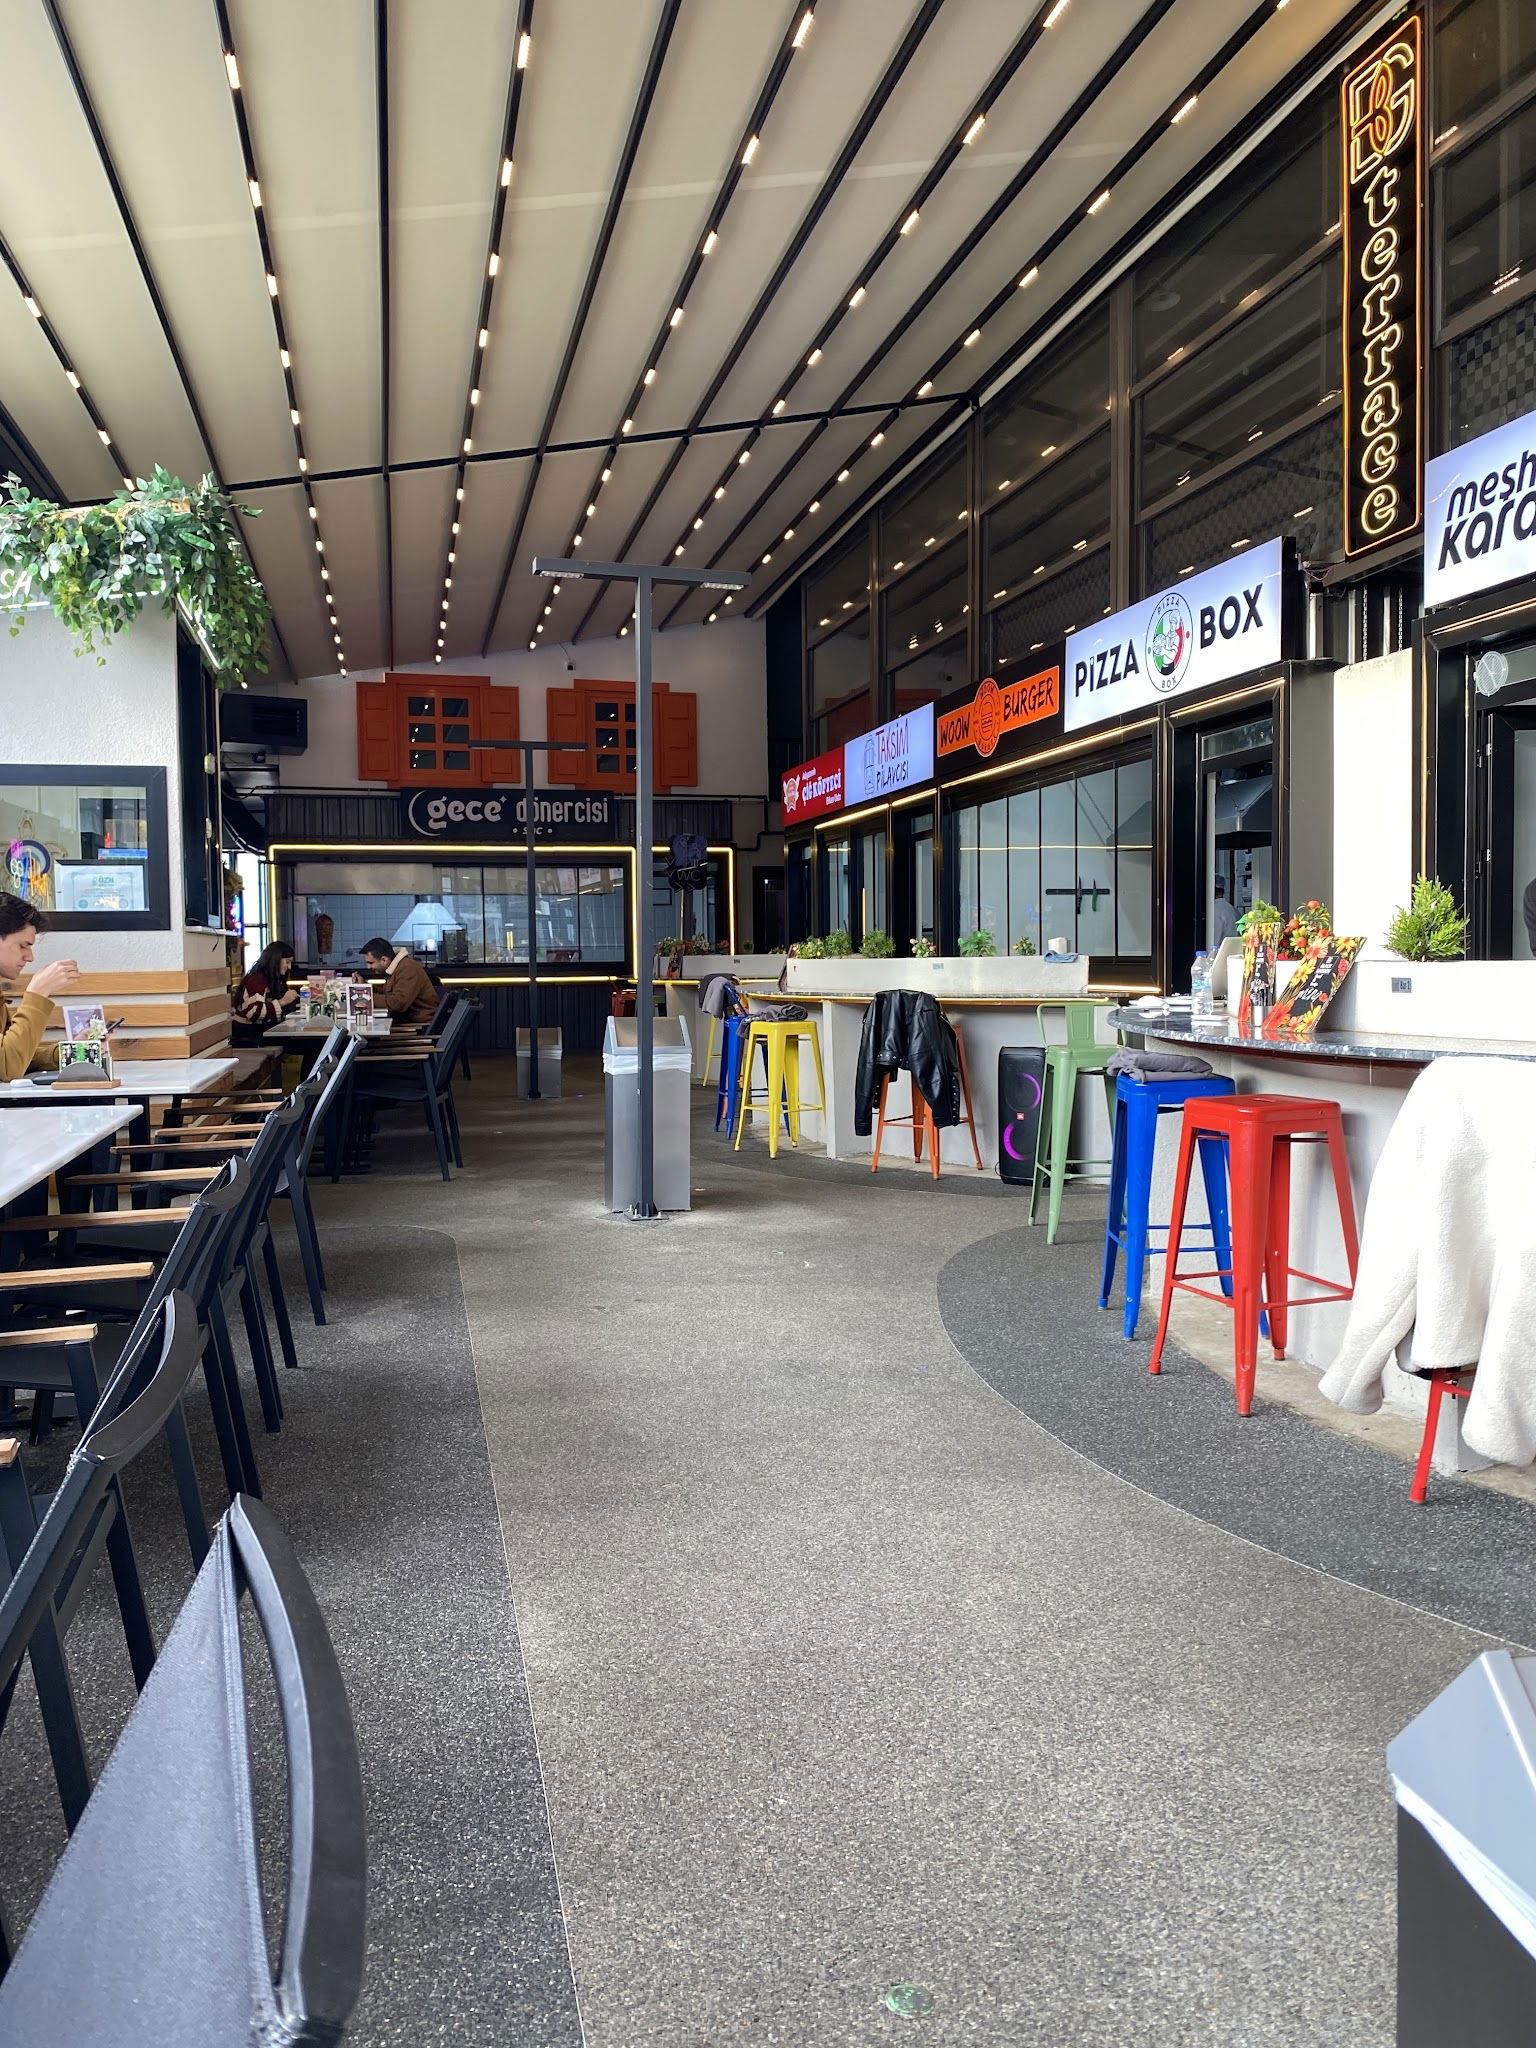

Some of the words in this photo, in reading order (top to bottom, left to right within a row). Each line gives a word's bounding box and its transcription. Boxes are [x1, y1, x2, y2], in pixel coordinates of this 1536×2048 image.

[1200, 583, 1264, 650] BOX
[940, 711, 971, 748] WOOW
[1003, 677, 1054, 722] BURGER
[427, 795, 502, 830] gece
[676, 869, 701, 882] WC
